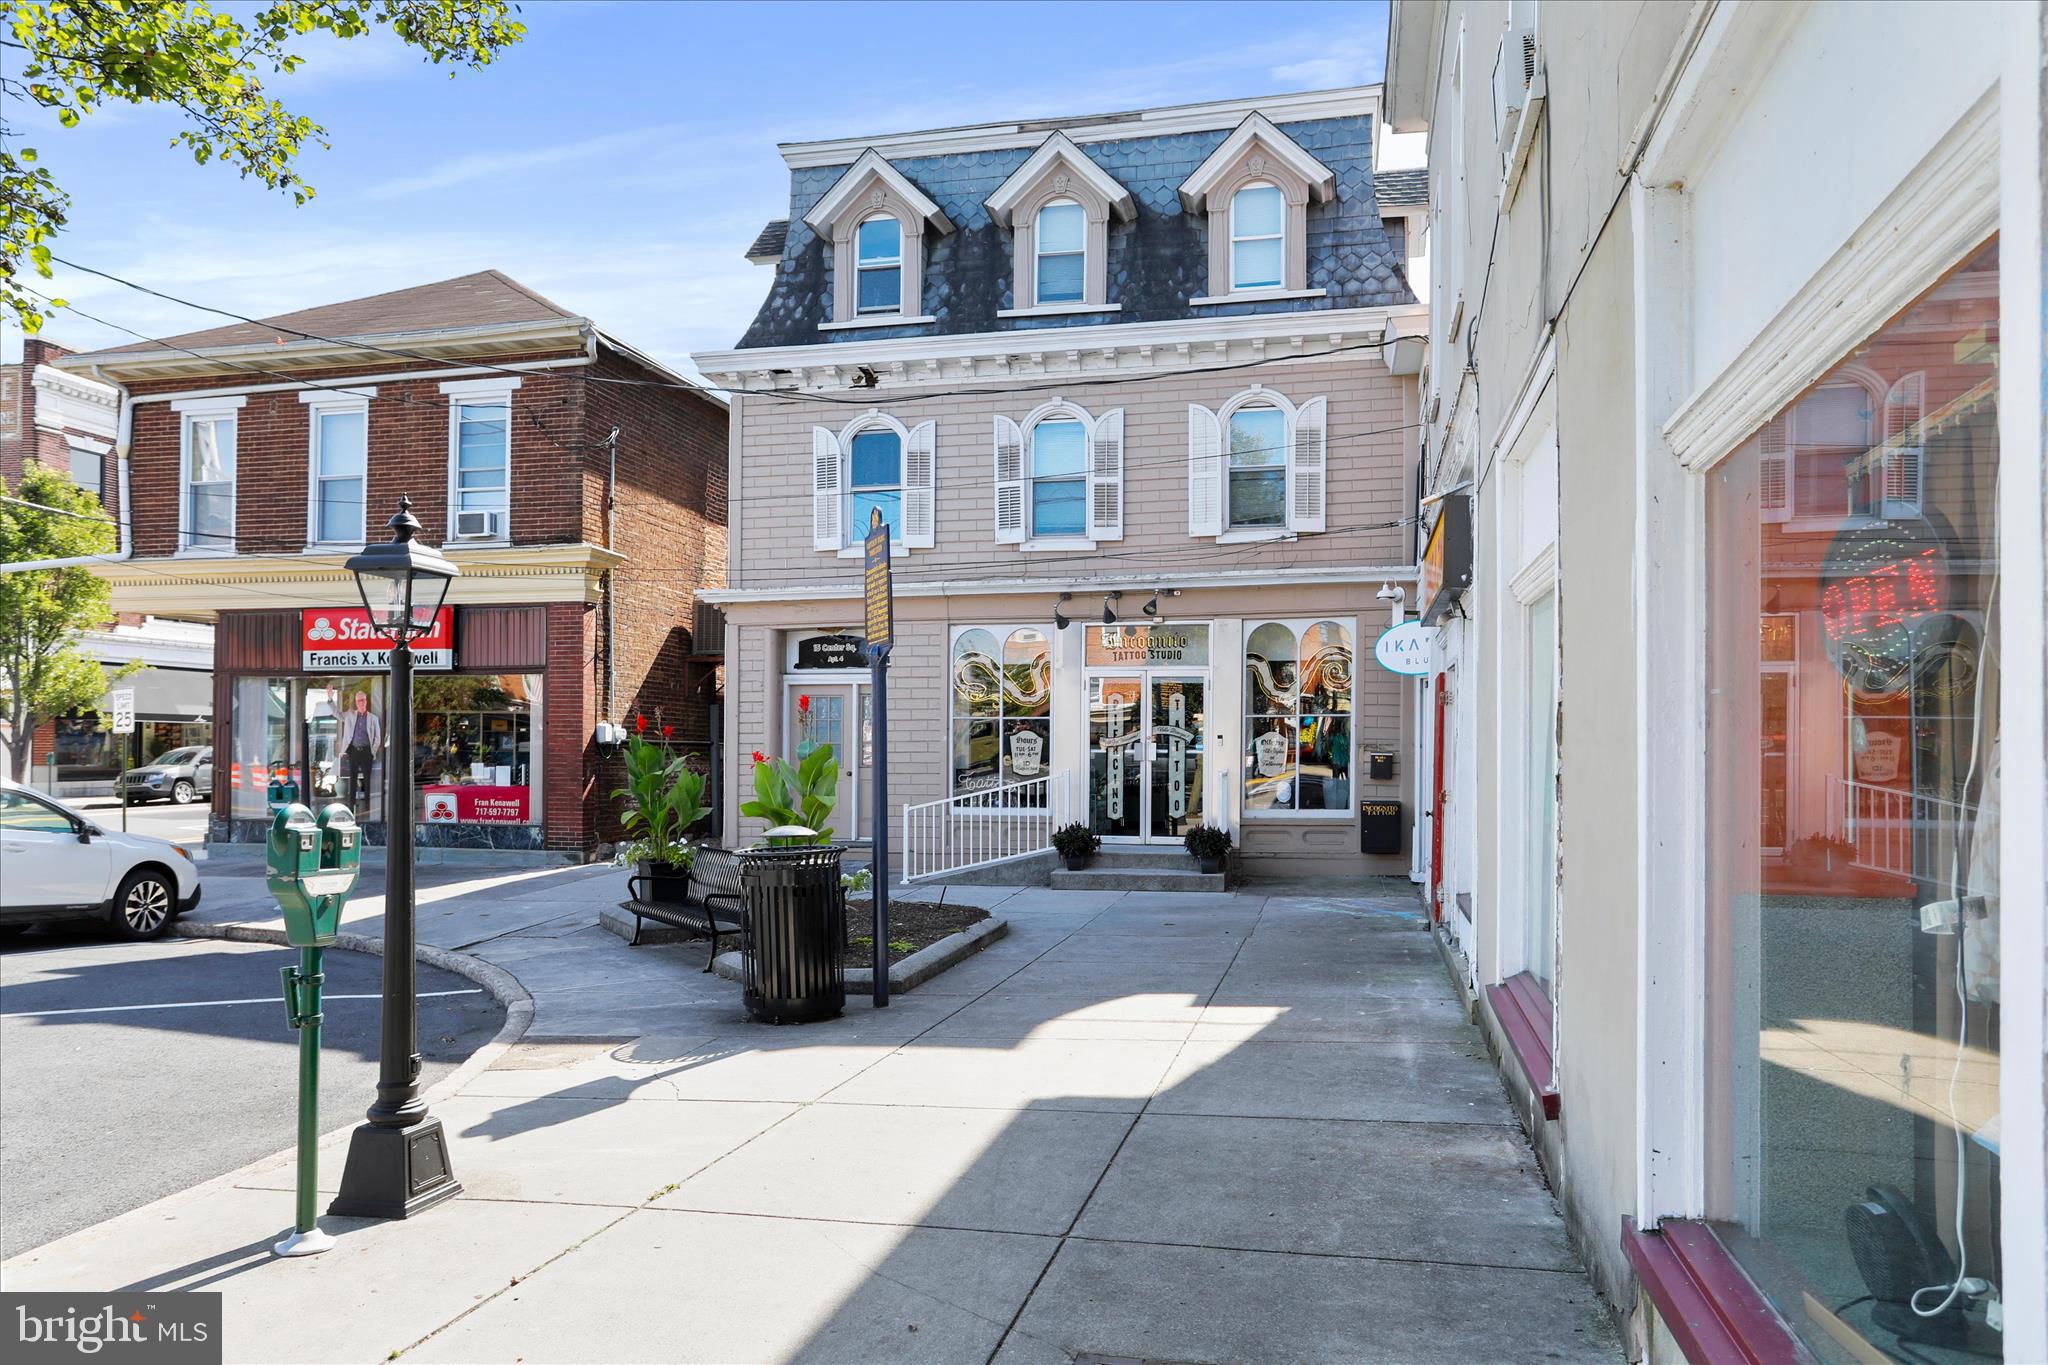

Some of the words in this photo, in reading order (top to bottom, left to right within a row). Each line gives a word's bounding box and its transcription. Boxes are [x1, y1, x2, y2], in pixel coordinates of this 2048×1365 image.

[1822, 549, 1938, 640] OPEN
[1104, 632, 1189, 650] Incognito
[310, 652, 358, 666] Francis
[361, 652, 374, 666] X.
[378, 651, 438, 666] Kwell
[1113, 651, 1147, 661] TATTOO
[1149, 650, 1182, 660] STUDIO
[116, 711, 132, 727] 25
[474, 799, 489, 807] Fran
[490, 799, 520, 807] Kenawell
